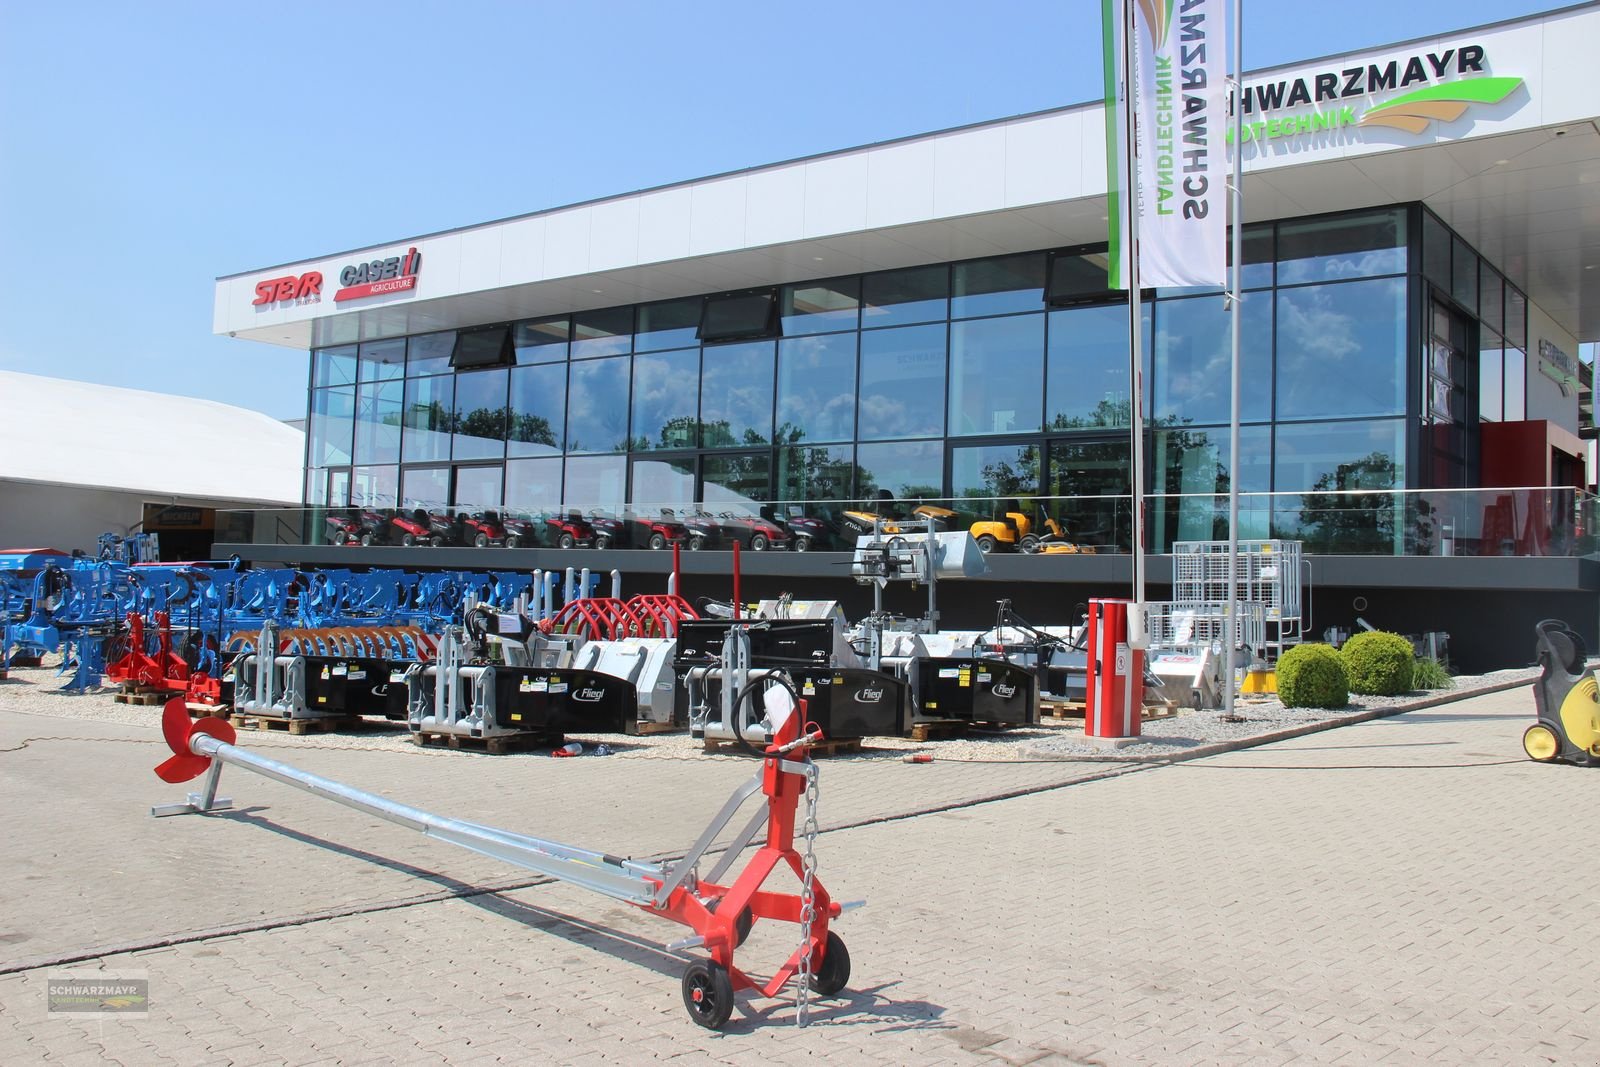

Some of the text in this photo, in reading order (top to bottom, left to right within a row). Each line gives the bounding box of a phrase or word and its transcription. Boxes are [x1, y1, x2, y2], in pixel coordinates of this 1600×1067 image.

[1225, 45, 1485, 117] HWARZMAYR
[1226, 106, 1356, 144] DTECHNIK
[252, 271, 323, 305] STEYR
[370, 279, 411, 293] AGRICULTURE
[580, 688, 605, 700] Fliegl
[863, 688, 884, 701] Fliegl
[998, 684, 1016, 697] Fliegl
